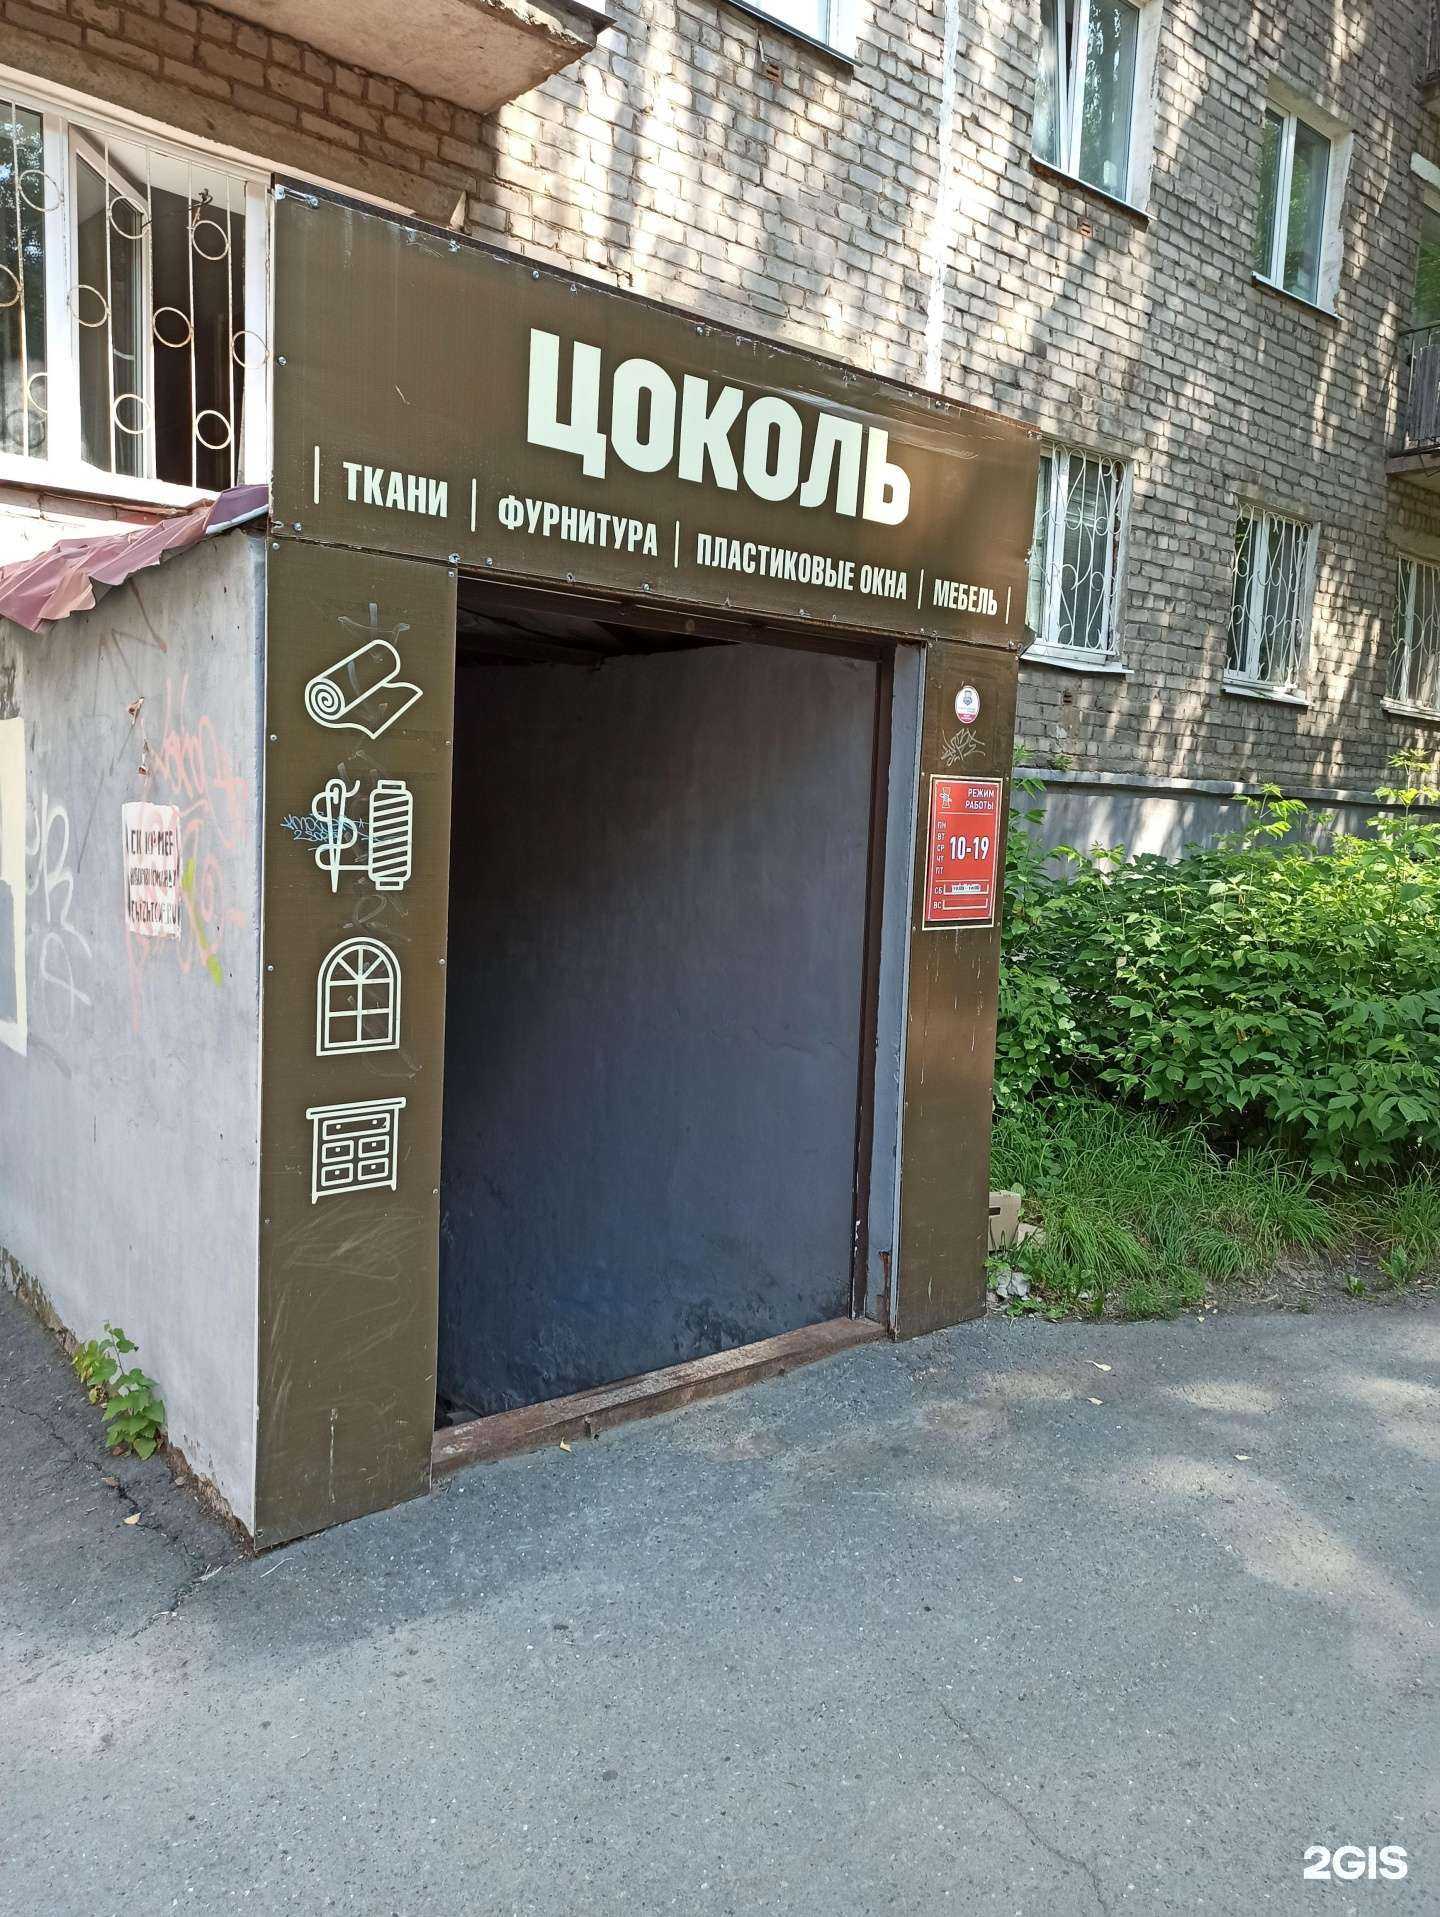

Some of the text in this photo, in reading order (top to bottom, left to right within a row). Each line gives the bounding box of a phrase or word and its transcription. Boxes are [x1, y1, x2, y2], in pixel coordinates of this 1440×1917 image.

[527, 327, 912, 527] ЦОКОЛЬ
[342, 461, 998, 616] ТКАНИ ФУРНИТУРА ПЛАСТИКОВЫЕ ОКНА МЕБЕЛЬ
[967, 788, 995, 799] РЕЖИМ
[964, 800, 994, 811] РАБОТЫ
[937, 821, 947, 829] ПН
[937, 832, 946, 841] ВТ
[936, 844, 945, 852] СР
[949, 835, 990, 861] 10-19
[936, 855, 945, 863] ЧТ
[935, 866, 944, 875] ПТ
[934, 886, 944, 895] СБ
[933, 901, 942, 909] ВС
